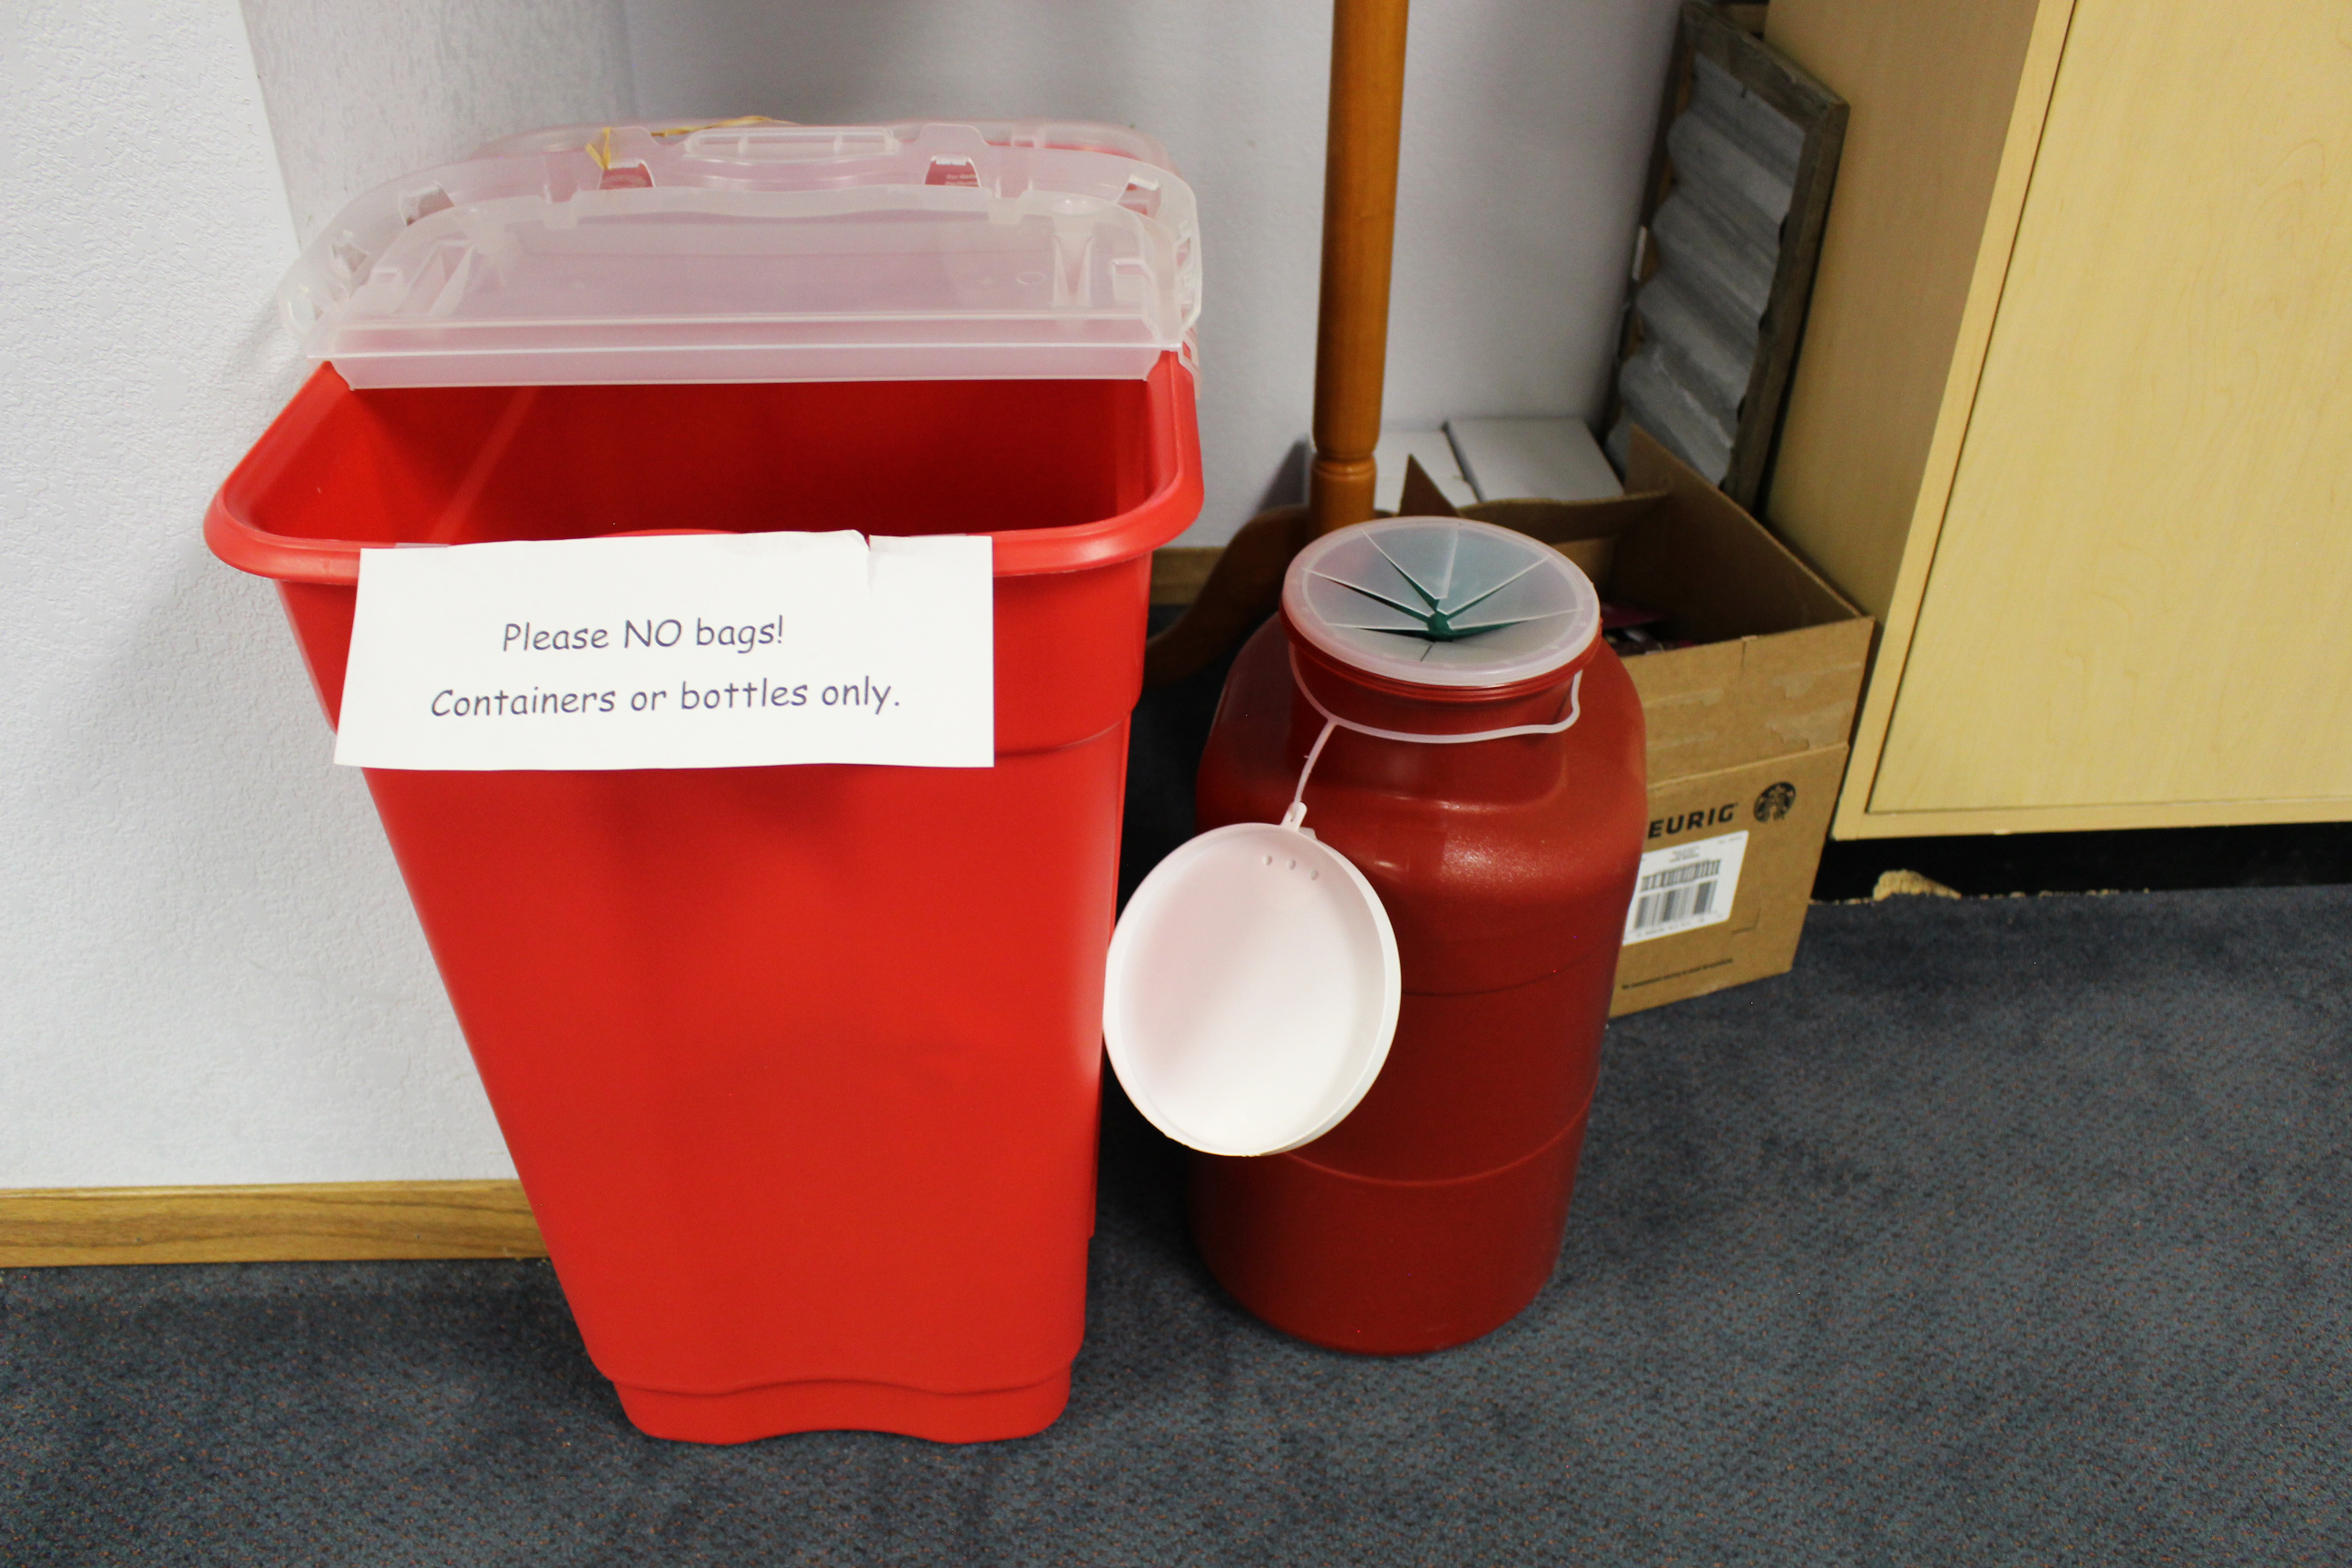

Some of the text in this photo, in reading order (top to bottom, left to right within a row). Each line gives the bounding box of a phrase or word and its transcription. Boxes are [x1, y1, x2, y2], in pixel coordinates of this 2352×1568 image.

[503, 614, 783, 654] Please NO bags!
[431, 675, 900, 717] Containers or bottles only.
[1647, 802, 1738, 839] EURIG
